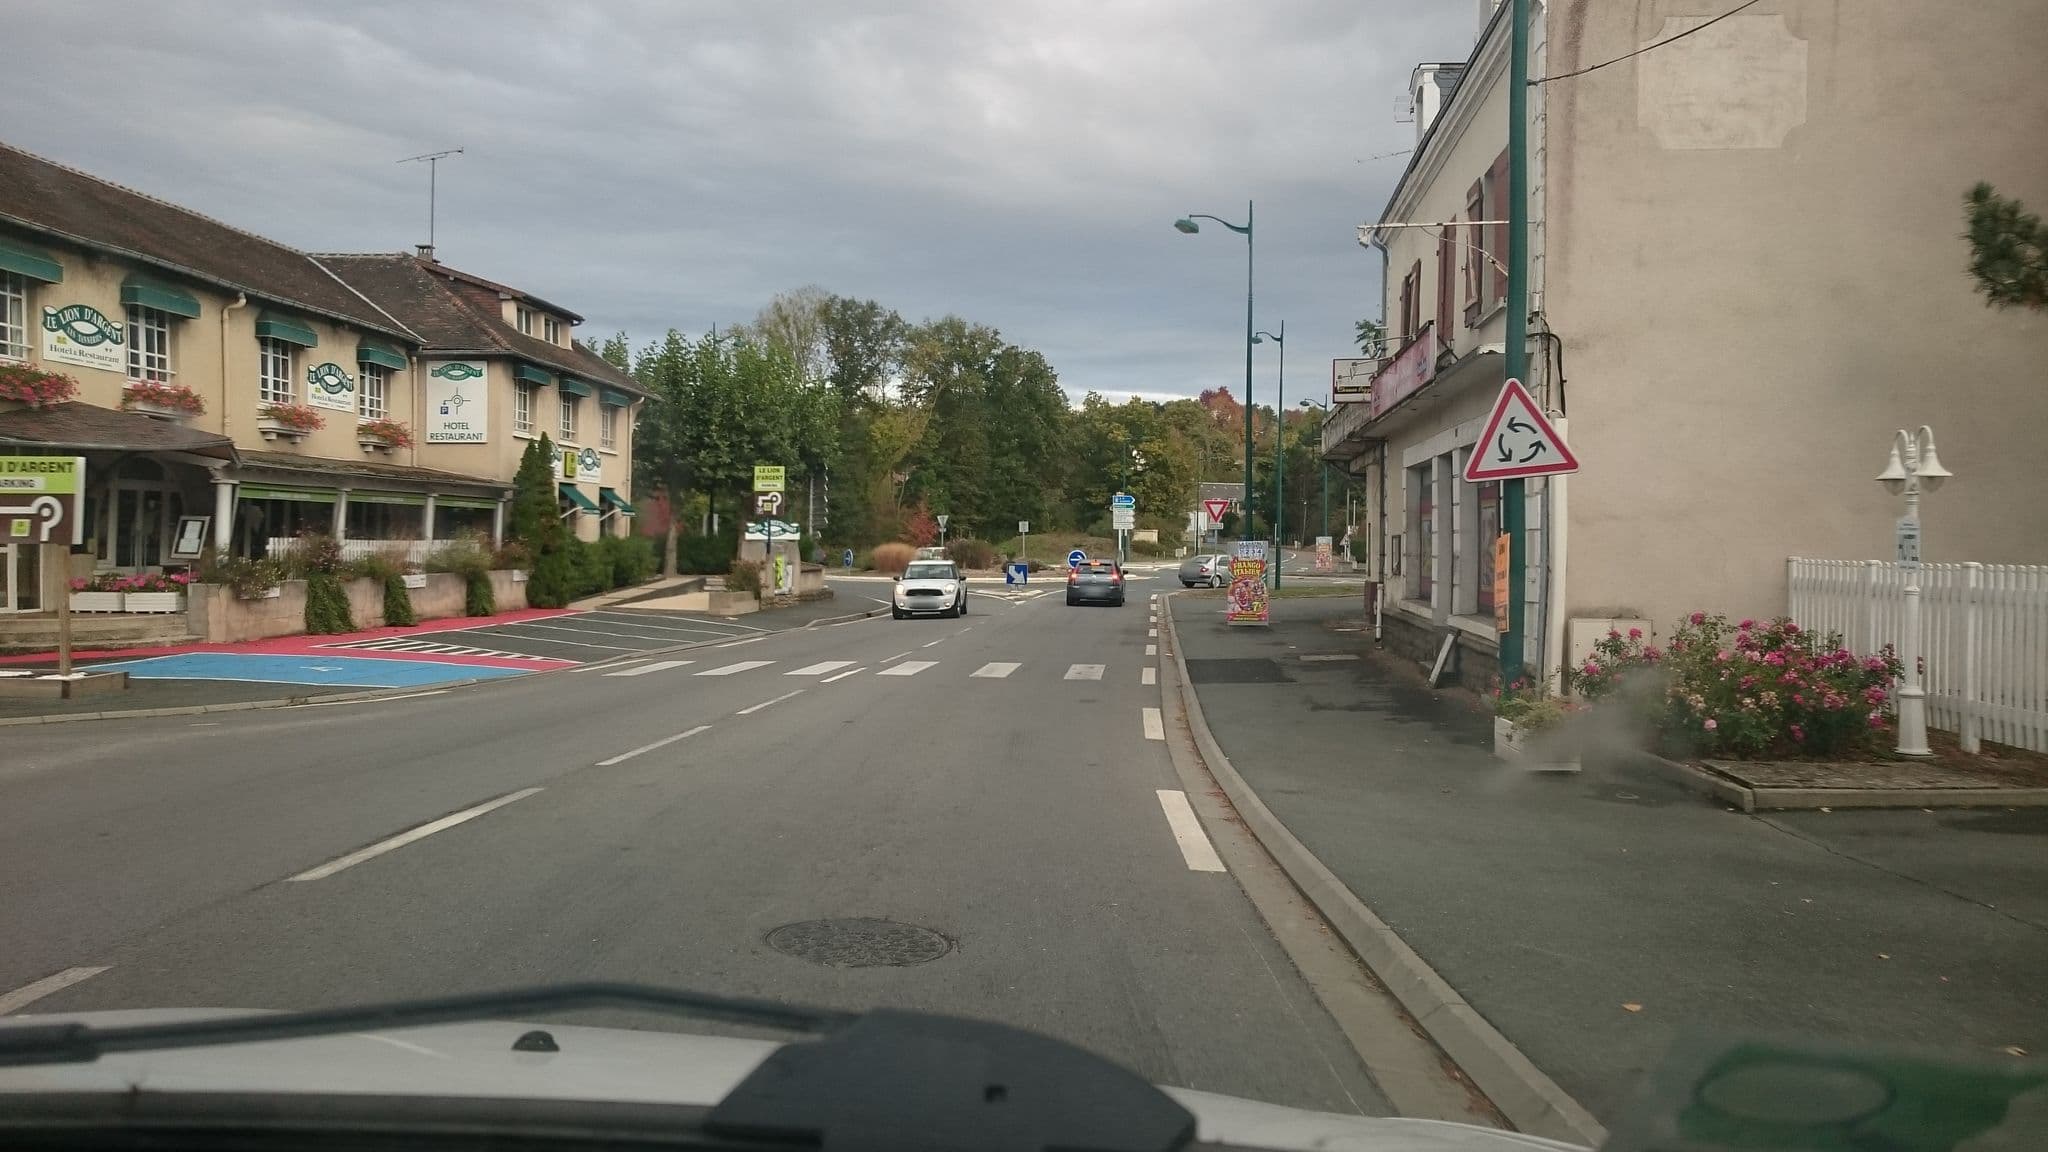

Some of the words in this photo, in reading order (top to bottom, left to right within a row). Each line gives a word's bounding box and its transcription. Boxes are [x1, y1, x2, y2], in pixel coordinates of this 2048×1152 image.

[46, 316, 58, 329] LE
[59, 307, 81, 325] LION
[84, 308, 122, 343] D'ARGENT
[49, 344, 73, 355] Hotel
[78, 349, 120, 363] Restaurant
[443, 421, 469, 430] HOTEL
[429, 432, 484, 441] RESTAURANT
[7, 461, 74, 473] D'ARGENT
